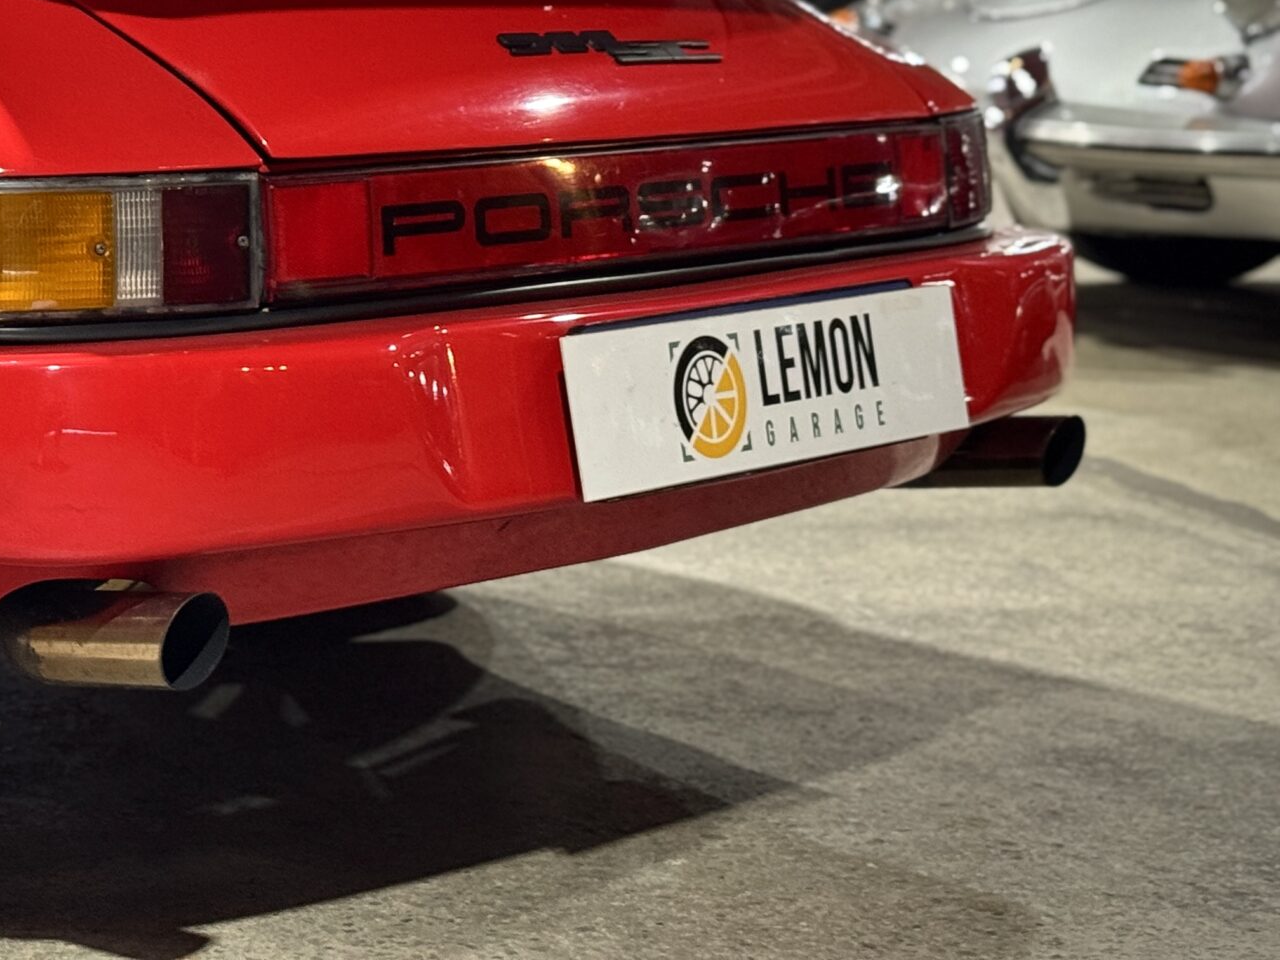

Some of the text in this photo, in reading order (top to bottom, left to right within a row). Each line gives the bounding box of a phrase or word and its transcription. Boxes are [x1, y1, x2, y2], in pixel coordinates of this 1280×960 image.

[381, 161, 893, 256] PORSCHE
[753, 313, 880, 407] LEMON
[765, 400, 886, 446] GARAGE
